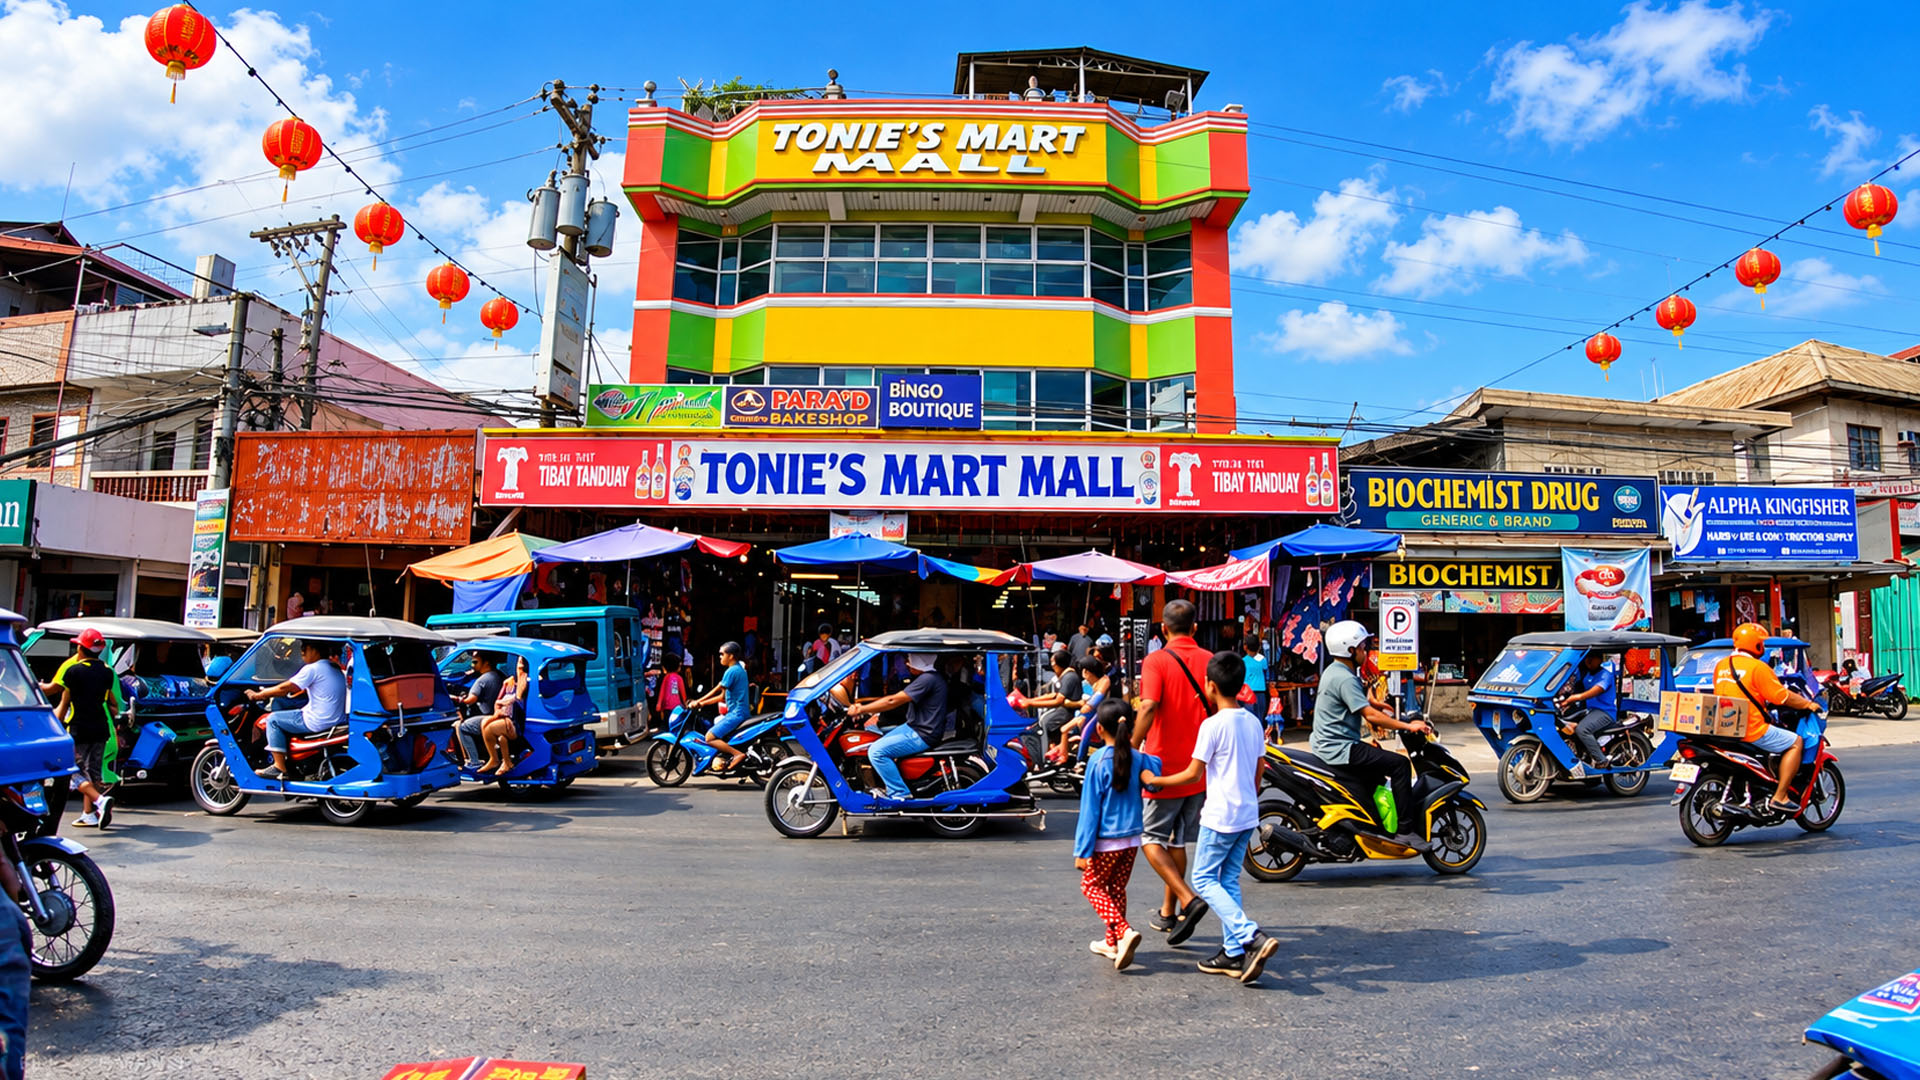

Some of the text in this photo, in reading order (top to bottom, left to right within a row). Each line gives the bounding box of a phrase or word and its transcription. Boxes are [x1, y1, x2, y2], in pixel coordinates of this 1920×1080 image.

[773, 122, 1087, 153] TONIE'S MART
[812, 152, 1046, 174] MALL
[770, 412, 868, 425] BAKESHOP
[889, 401, 974, 421] BOUTIQUE
[539, 465, 630, 487] TIBAY TANDUAY
[700, 452, 1135, 498] TONIE'S MART MALL
[1212, 471, 1300, 493] TIBAY TANDUAY
[1368, 477, 1600, 511] BIOCHEMIST DRUG
[1708, 497, 1850, 515] ALPHA KINGFISHER
[1421, 514, 1483, 527] GENERIC
[1504, 515, 1551, 528] BRAND
[1389, 563, 1552, 586] BIOCHEMIST
[1393, 611, 1406, 630] P
